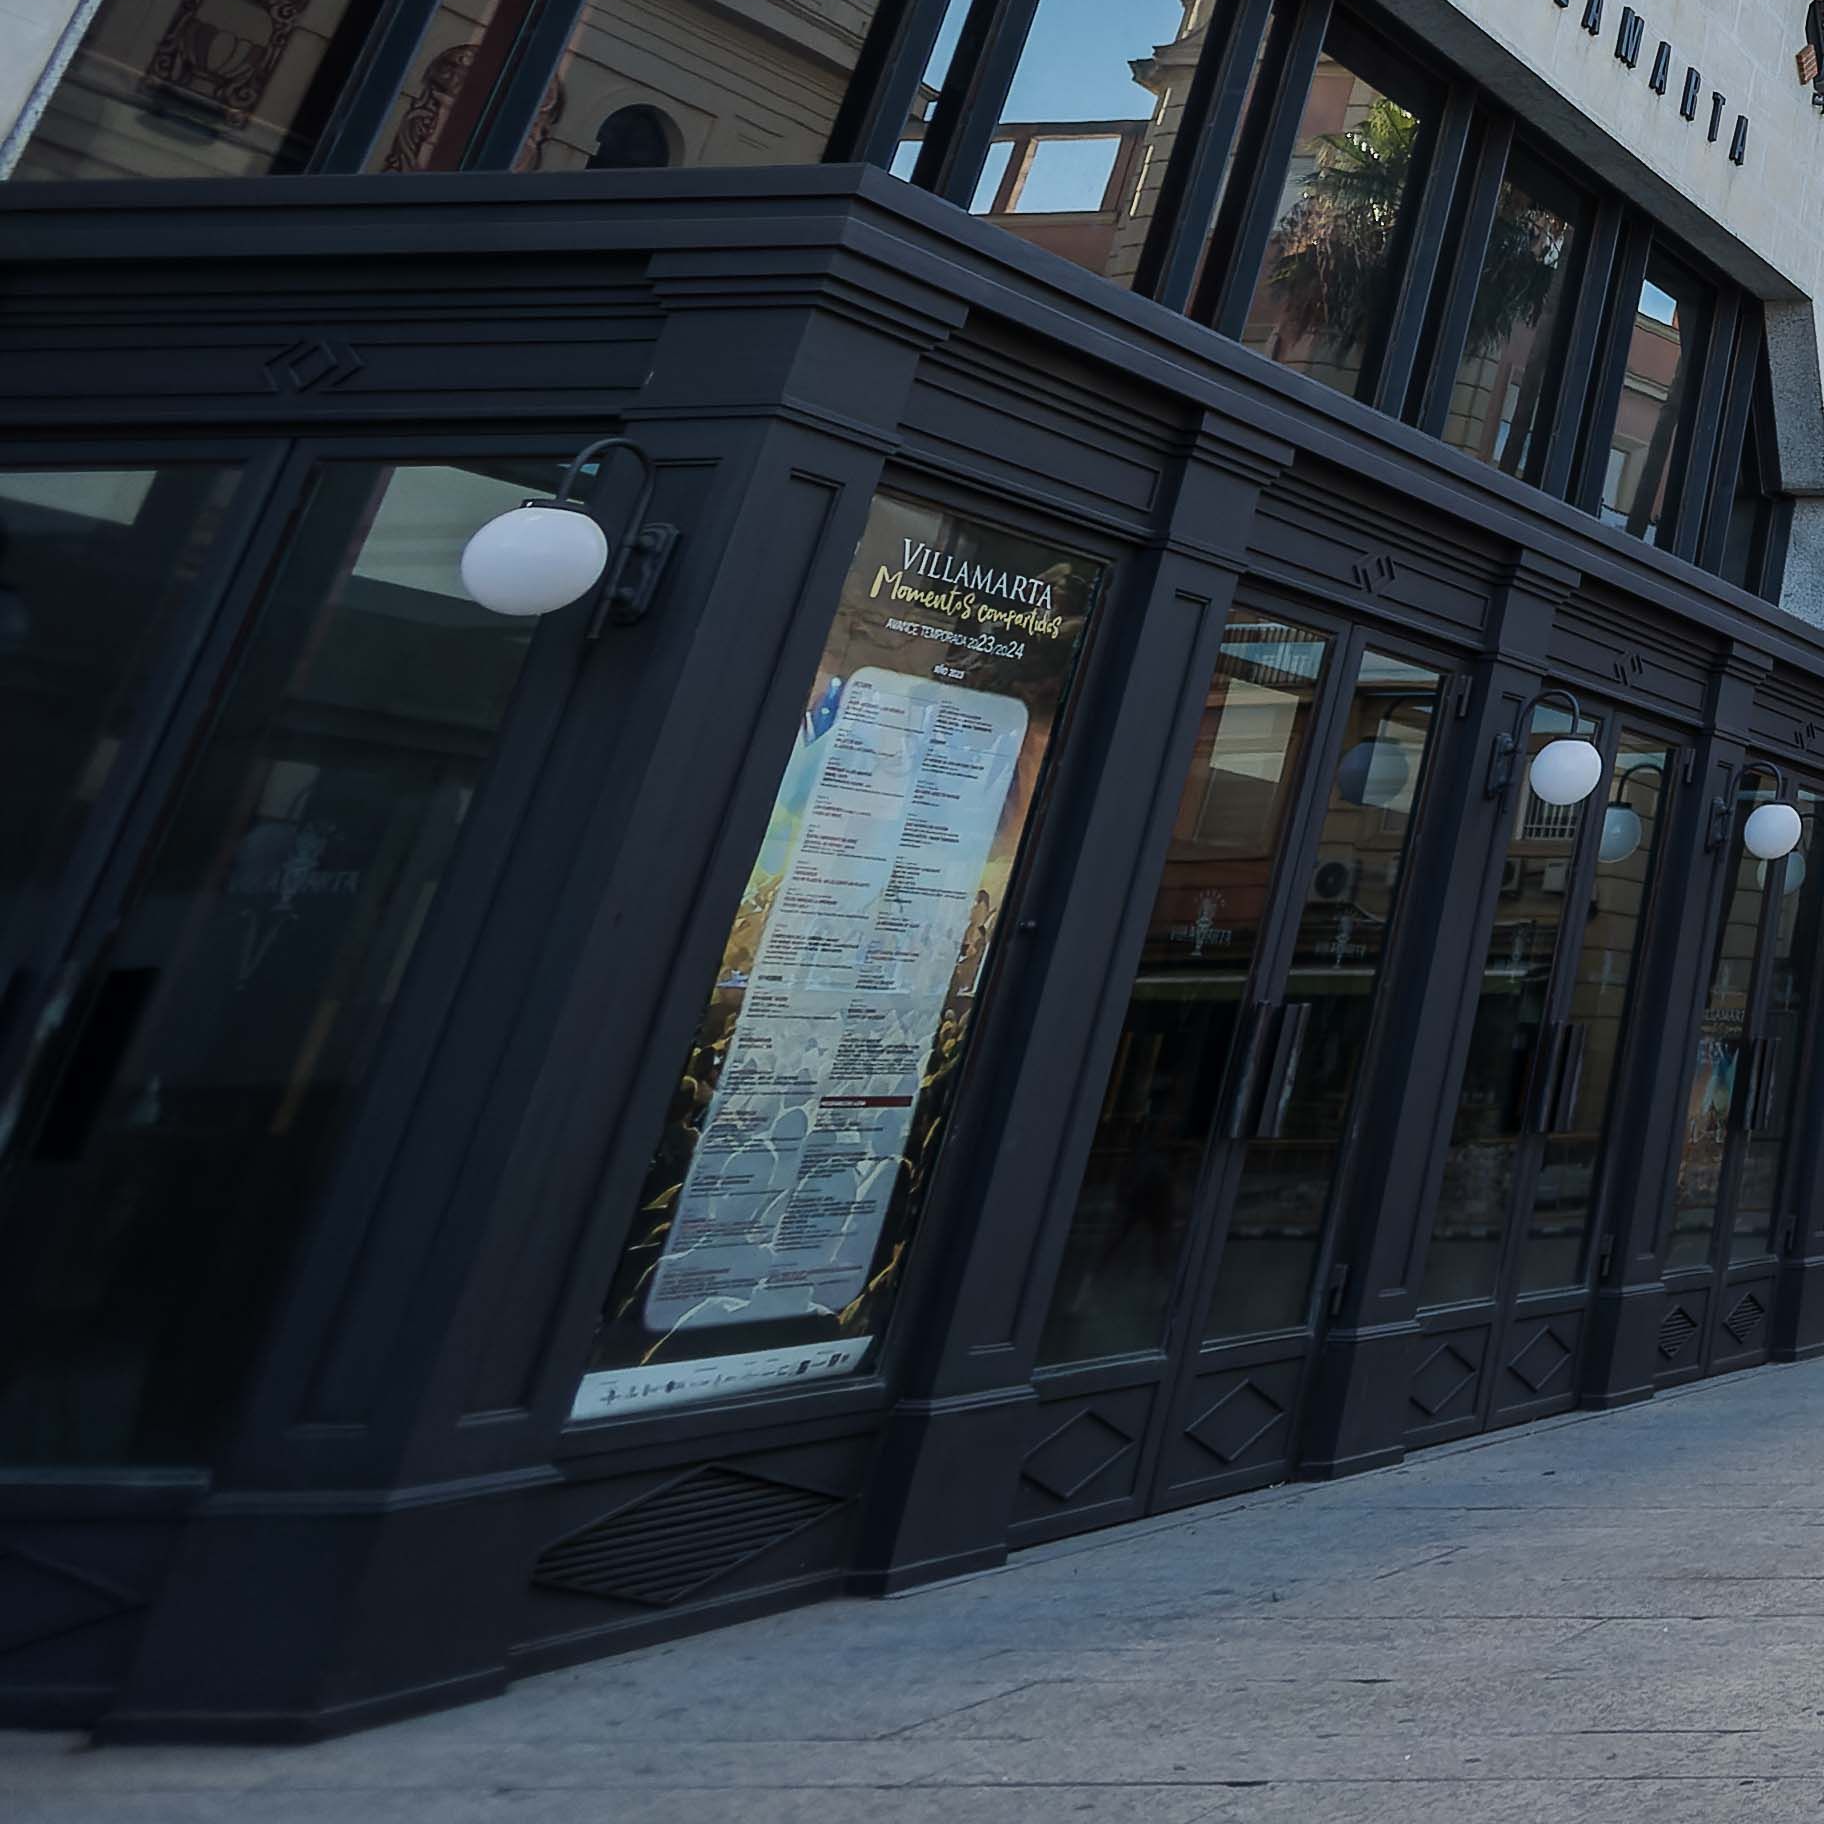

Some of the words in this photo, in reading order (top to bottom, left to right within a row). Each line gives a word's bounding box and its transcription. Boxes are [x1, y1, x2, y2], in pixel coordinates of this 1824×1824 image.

[869, 565, 976, 620] Momentos
[977, 603, 1063, 640] compartidos
[902, 537, 1053, 610] VILLAMARTA
